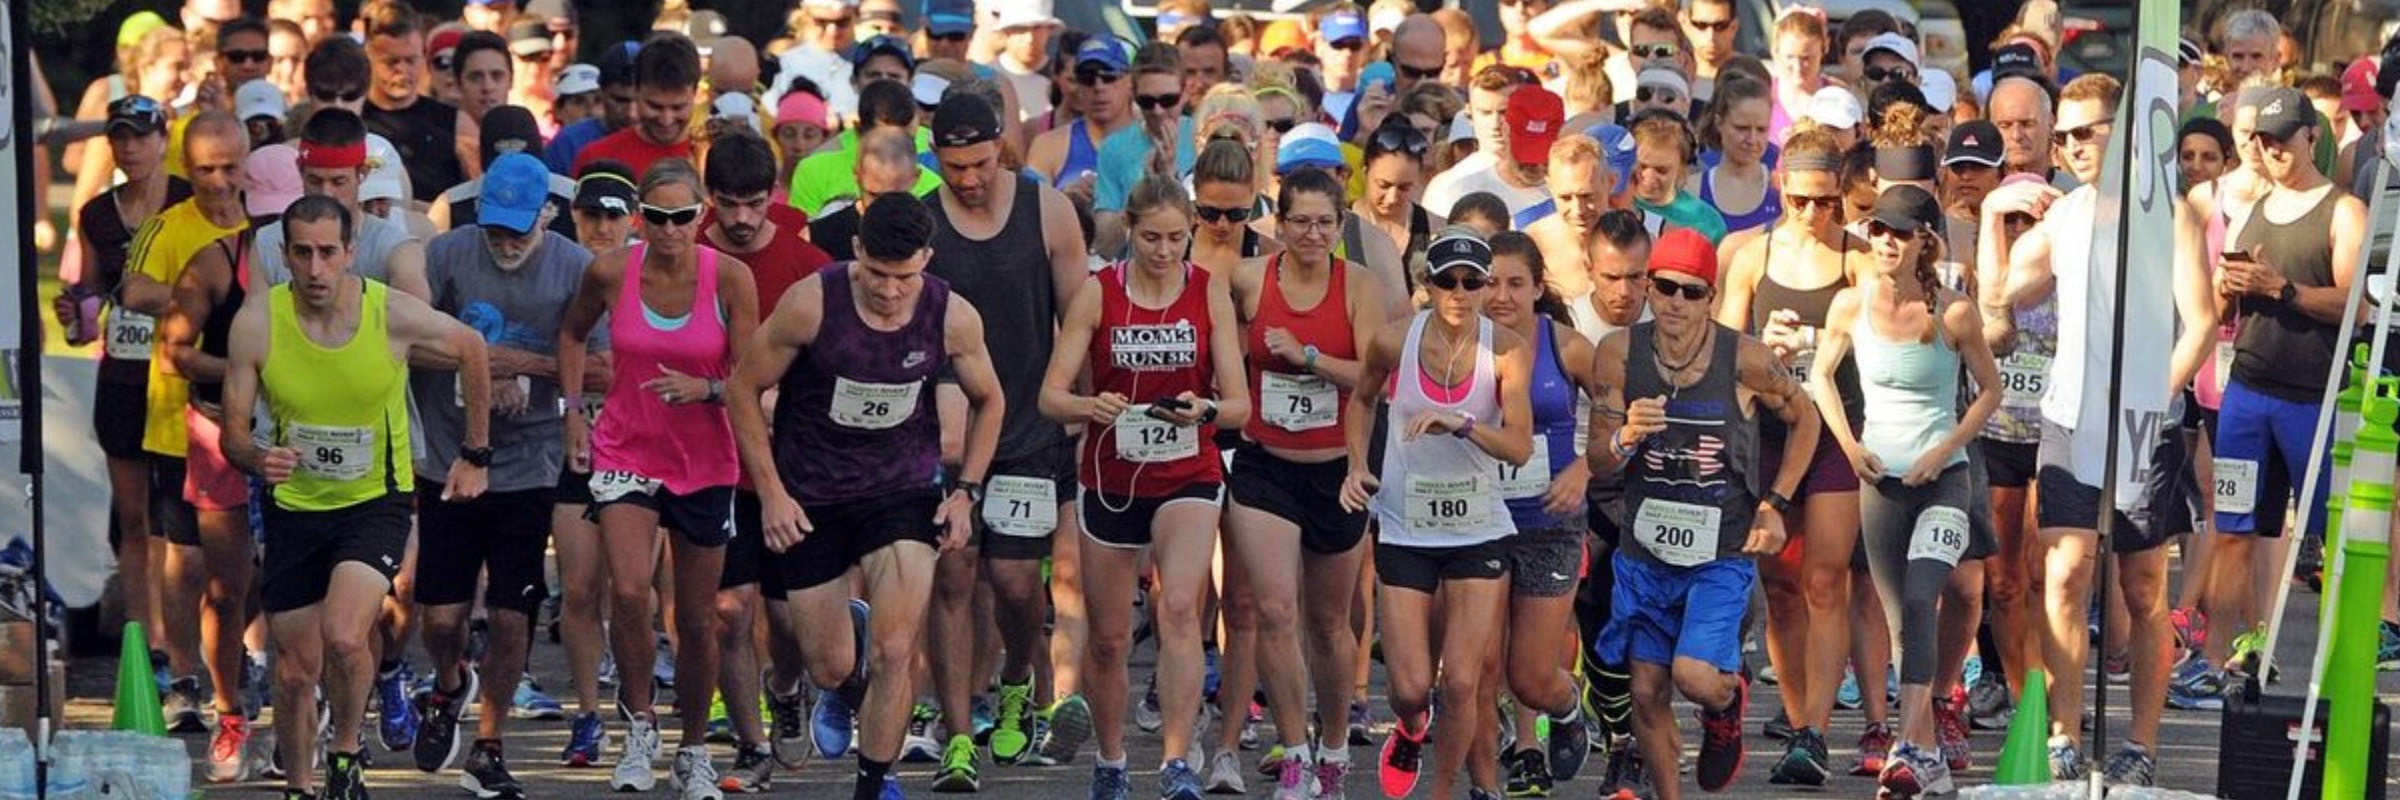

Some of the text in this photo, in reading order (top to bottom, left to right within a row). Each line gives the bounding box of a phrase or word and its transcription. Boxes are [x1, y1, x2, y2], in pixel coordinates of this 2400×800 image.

[1115, 352, 1165, 367] RUN
[1999, 371, 2043, 394] 985
[862, 401, 890, 416] 26
[1287, 394, 1313, 414] 79
[1139, 426, 1179, 446] 124
[315, 446, 344, 465] 96
[1009, 499, 1031, 518] 71
[1427, 499, 1468, 518] 180
[1655, 524, 1695, 549] 200
[1932, 527, 1963, 550] 186
